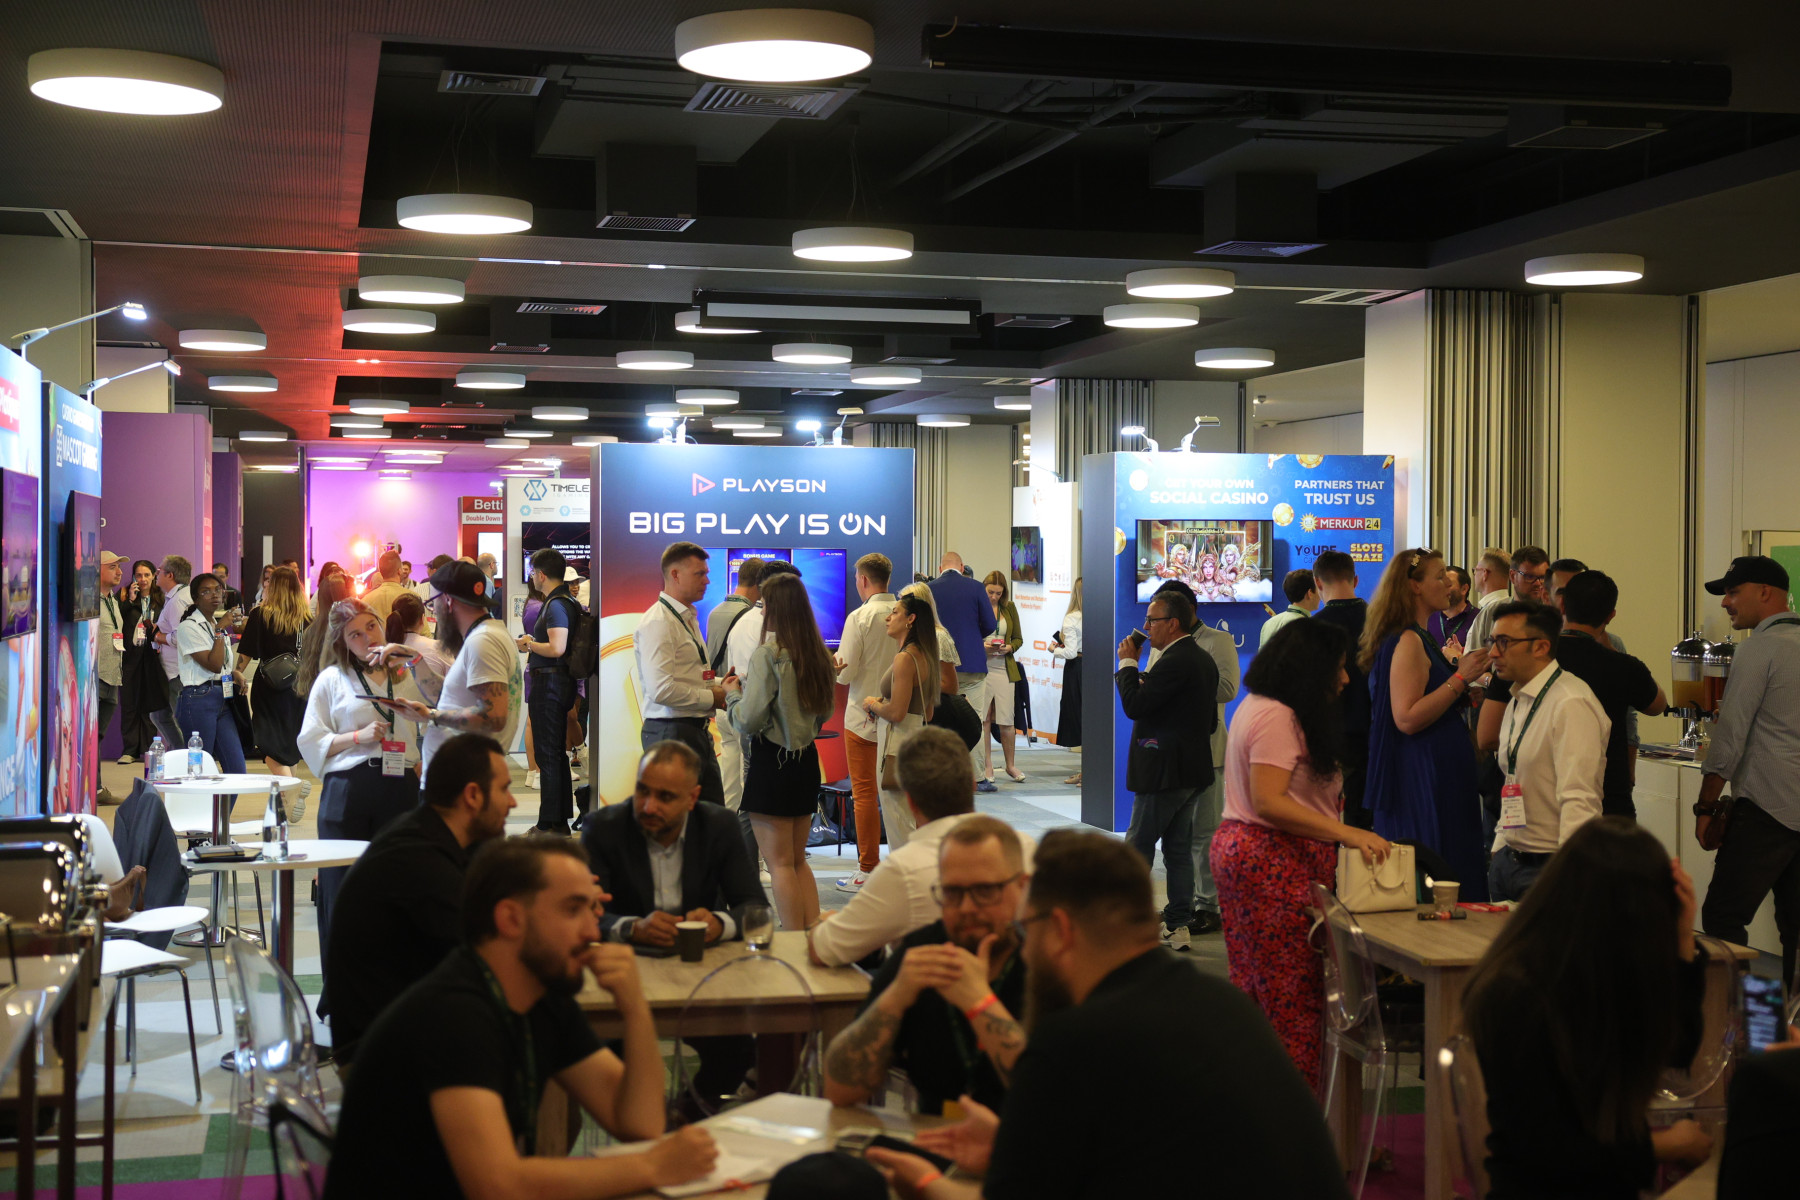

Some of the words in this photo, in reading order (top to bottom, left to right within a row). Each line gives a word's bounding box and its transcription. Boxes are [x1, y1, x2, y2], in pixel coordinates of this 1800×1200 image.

[62, 434, 82, 466] MASCOT
[551, 484, 590, 492] TIMELE
[722, 478, 826, 493] PLAYSON
[1164, 478, 1186, 488] GET
[1190, 478, 1222, 488] YOUR
[1224, 480, 1254, 489] OWN
[1294, 480, 1353, 489] PARTNERS
[1356, 480, 1385, 490] THAT
[1150, 492, 1207, 504] SOCIAL
[1210, 492, 1269, 504] CASINO
[1304, 493, 1351, 505] TRUST
[1356, 494, 1375, 505] US
[474, 499, 503, 510] Betti
[629, 512, 685, 534] BIG
[696, 512, 789, 534] PLAY
[800, 514, 830, 535] IS
[839, 512, 886, 536] ON
[1320, 519, 1363, 528] MERKUR
[1350, 543, 1383, 553] SLOTS
[1350, 553, 1383, 562] CRAZE
